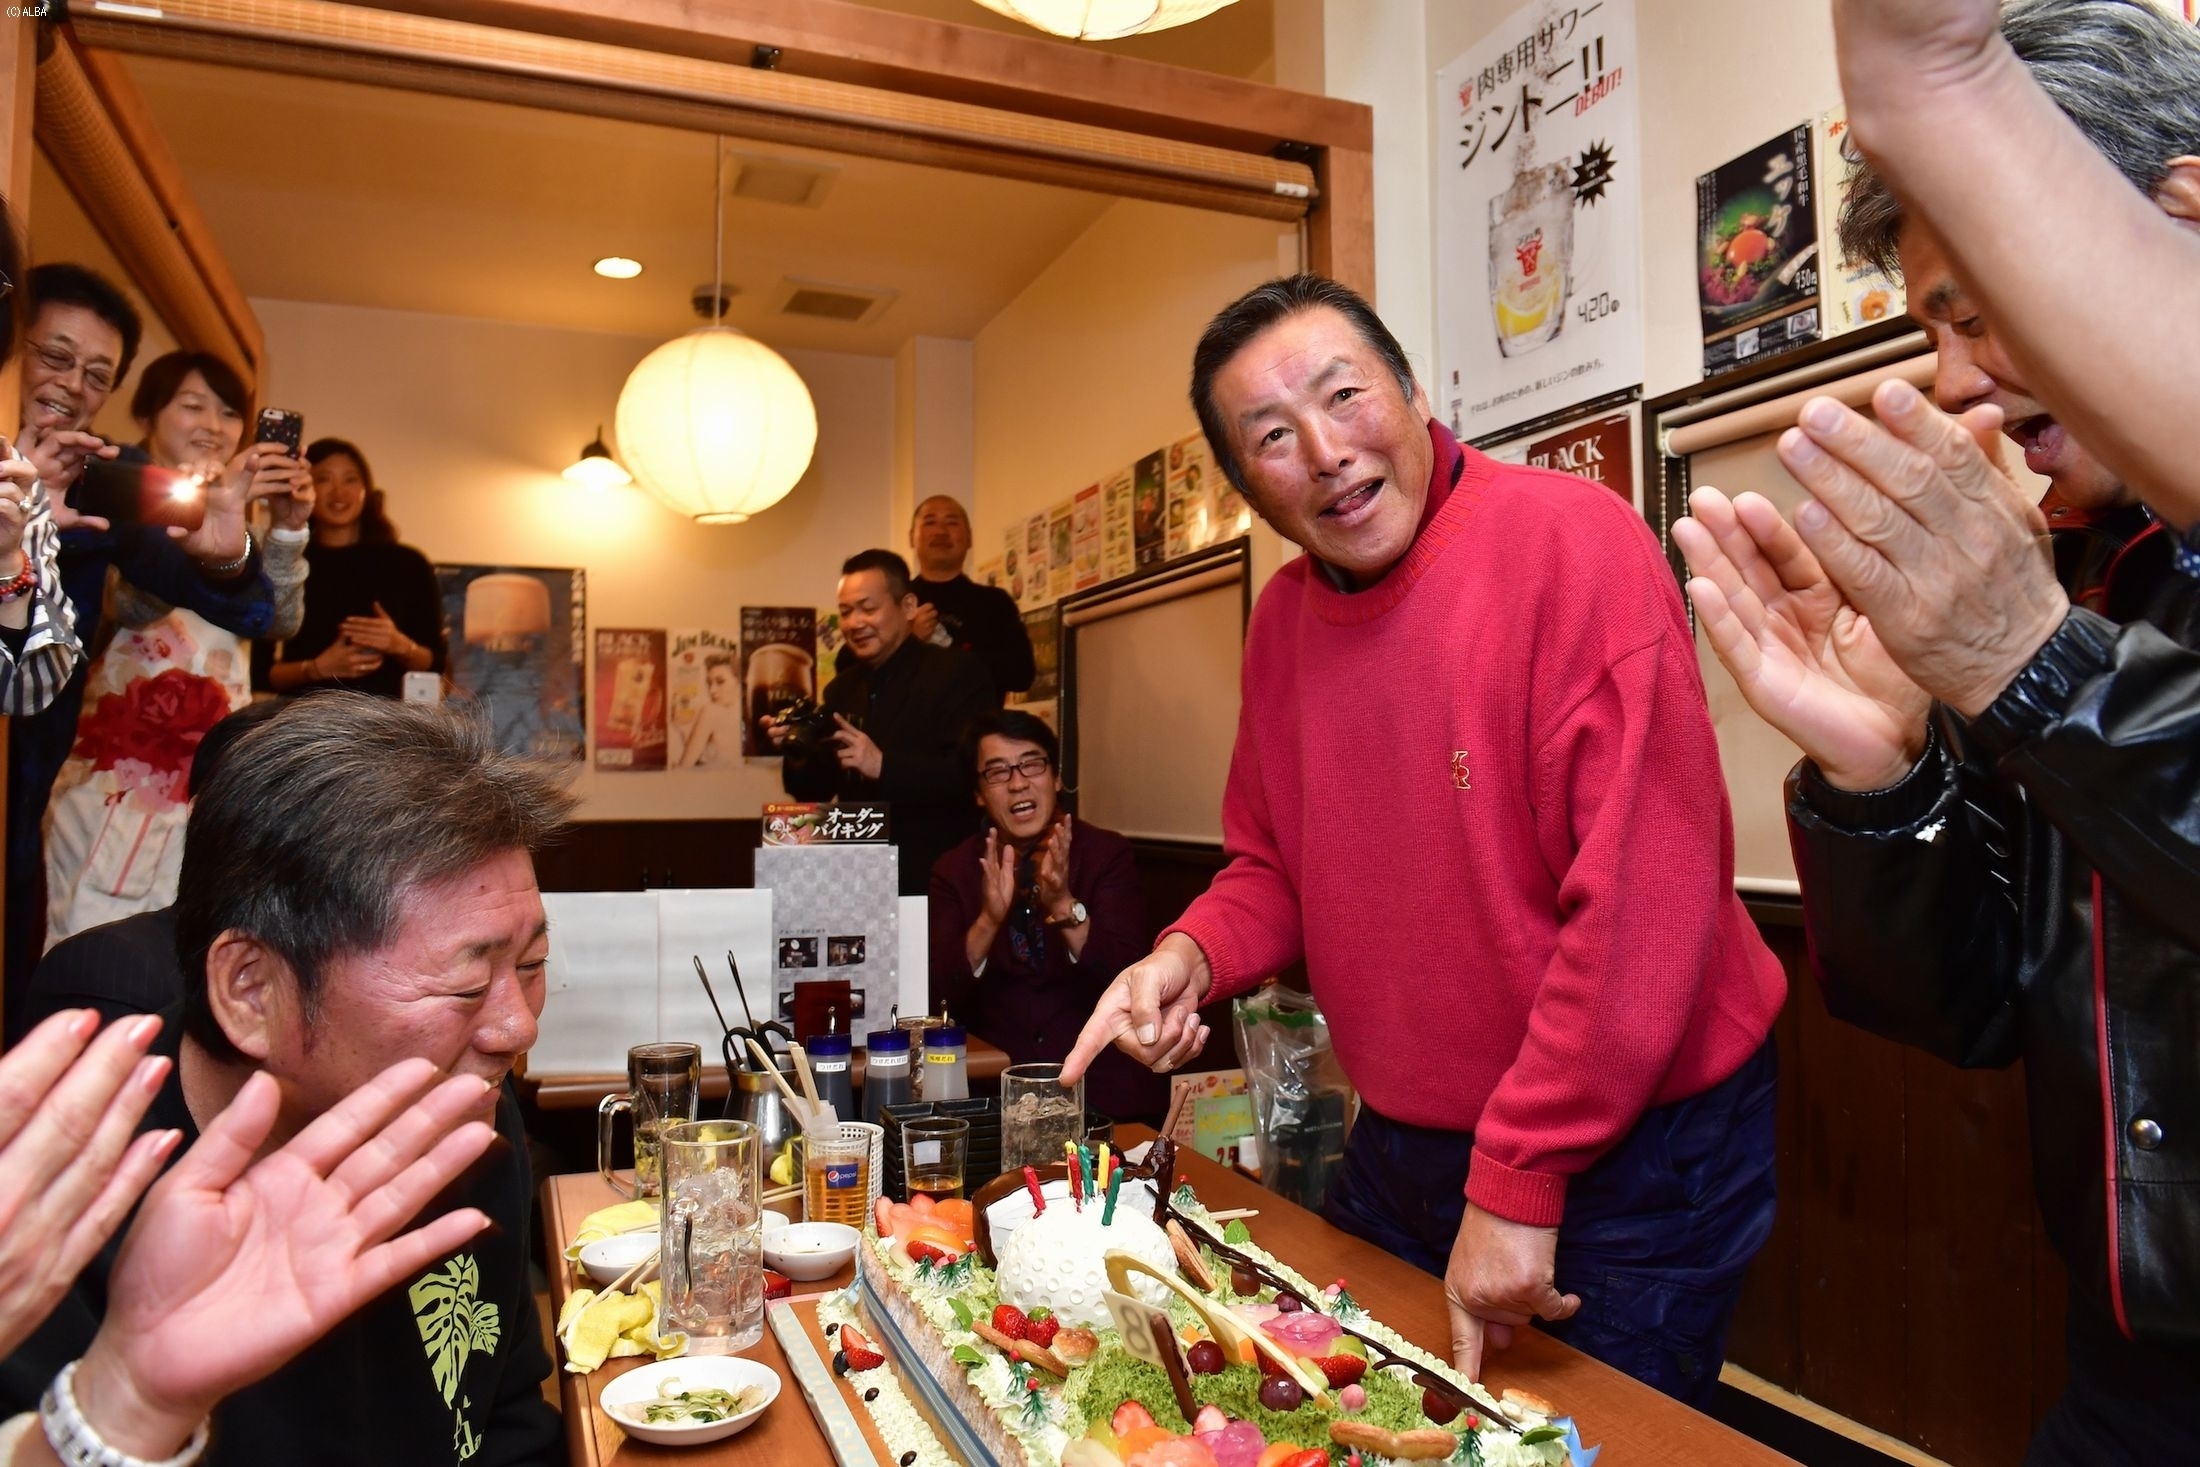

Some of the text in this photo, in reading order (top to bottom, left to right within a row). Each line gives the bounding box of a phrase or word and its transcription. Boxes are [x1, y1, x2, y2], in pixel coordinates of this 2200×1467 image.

[1476, 1, 1604, 102] 肉専用サワー
[1530, 434, 1605, 470] BLACK
[826, 807, 885, 824] オーダー
[811, 822, 885, 839] バイキング
[840, 1170, 857, 1180] pepsi
